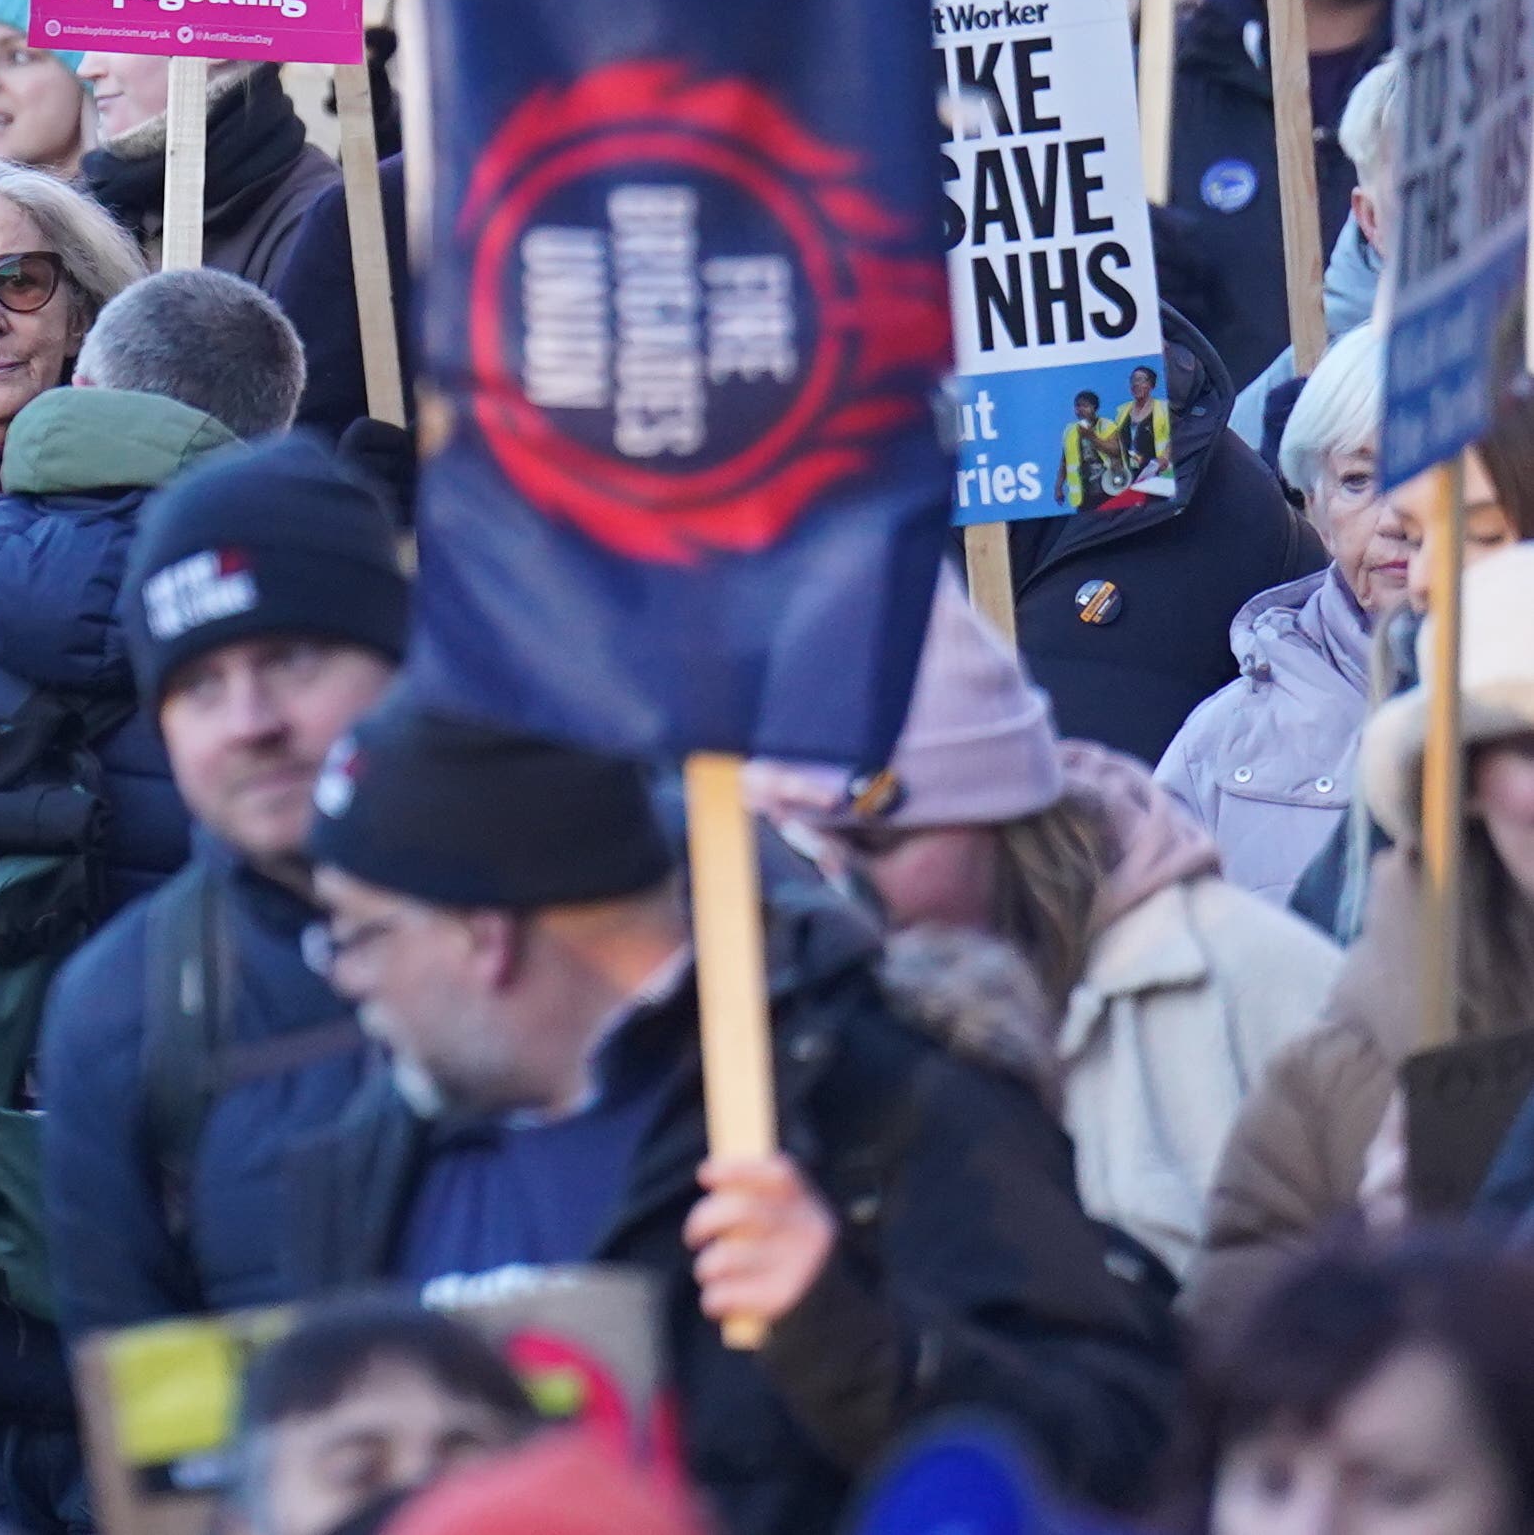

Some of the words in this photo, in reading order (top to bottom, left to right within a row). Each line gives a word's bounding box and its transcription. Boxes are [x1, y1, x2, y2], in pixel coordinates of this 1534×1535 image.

[970, 240, 1138, 353] NHS
[955, 388, 997, 442] ut
[957, 454, 1043, 508] ries
